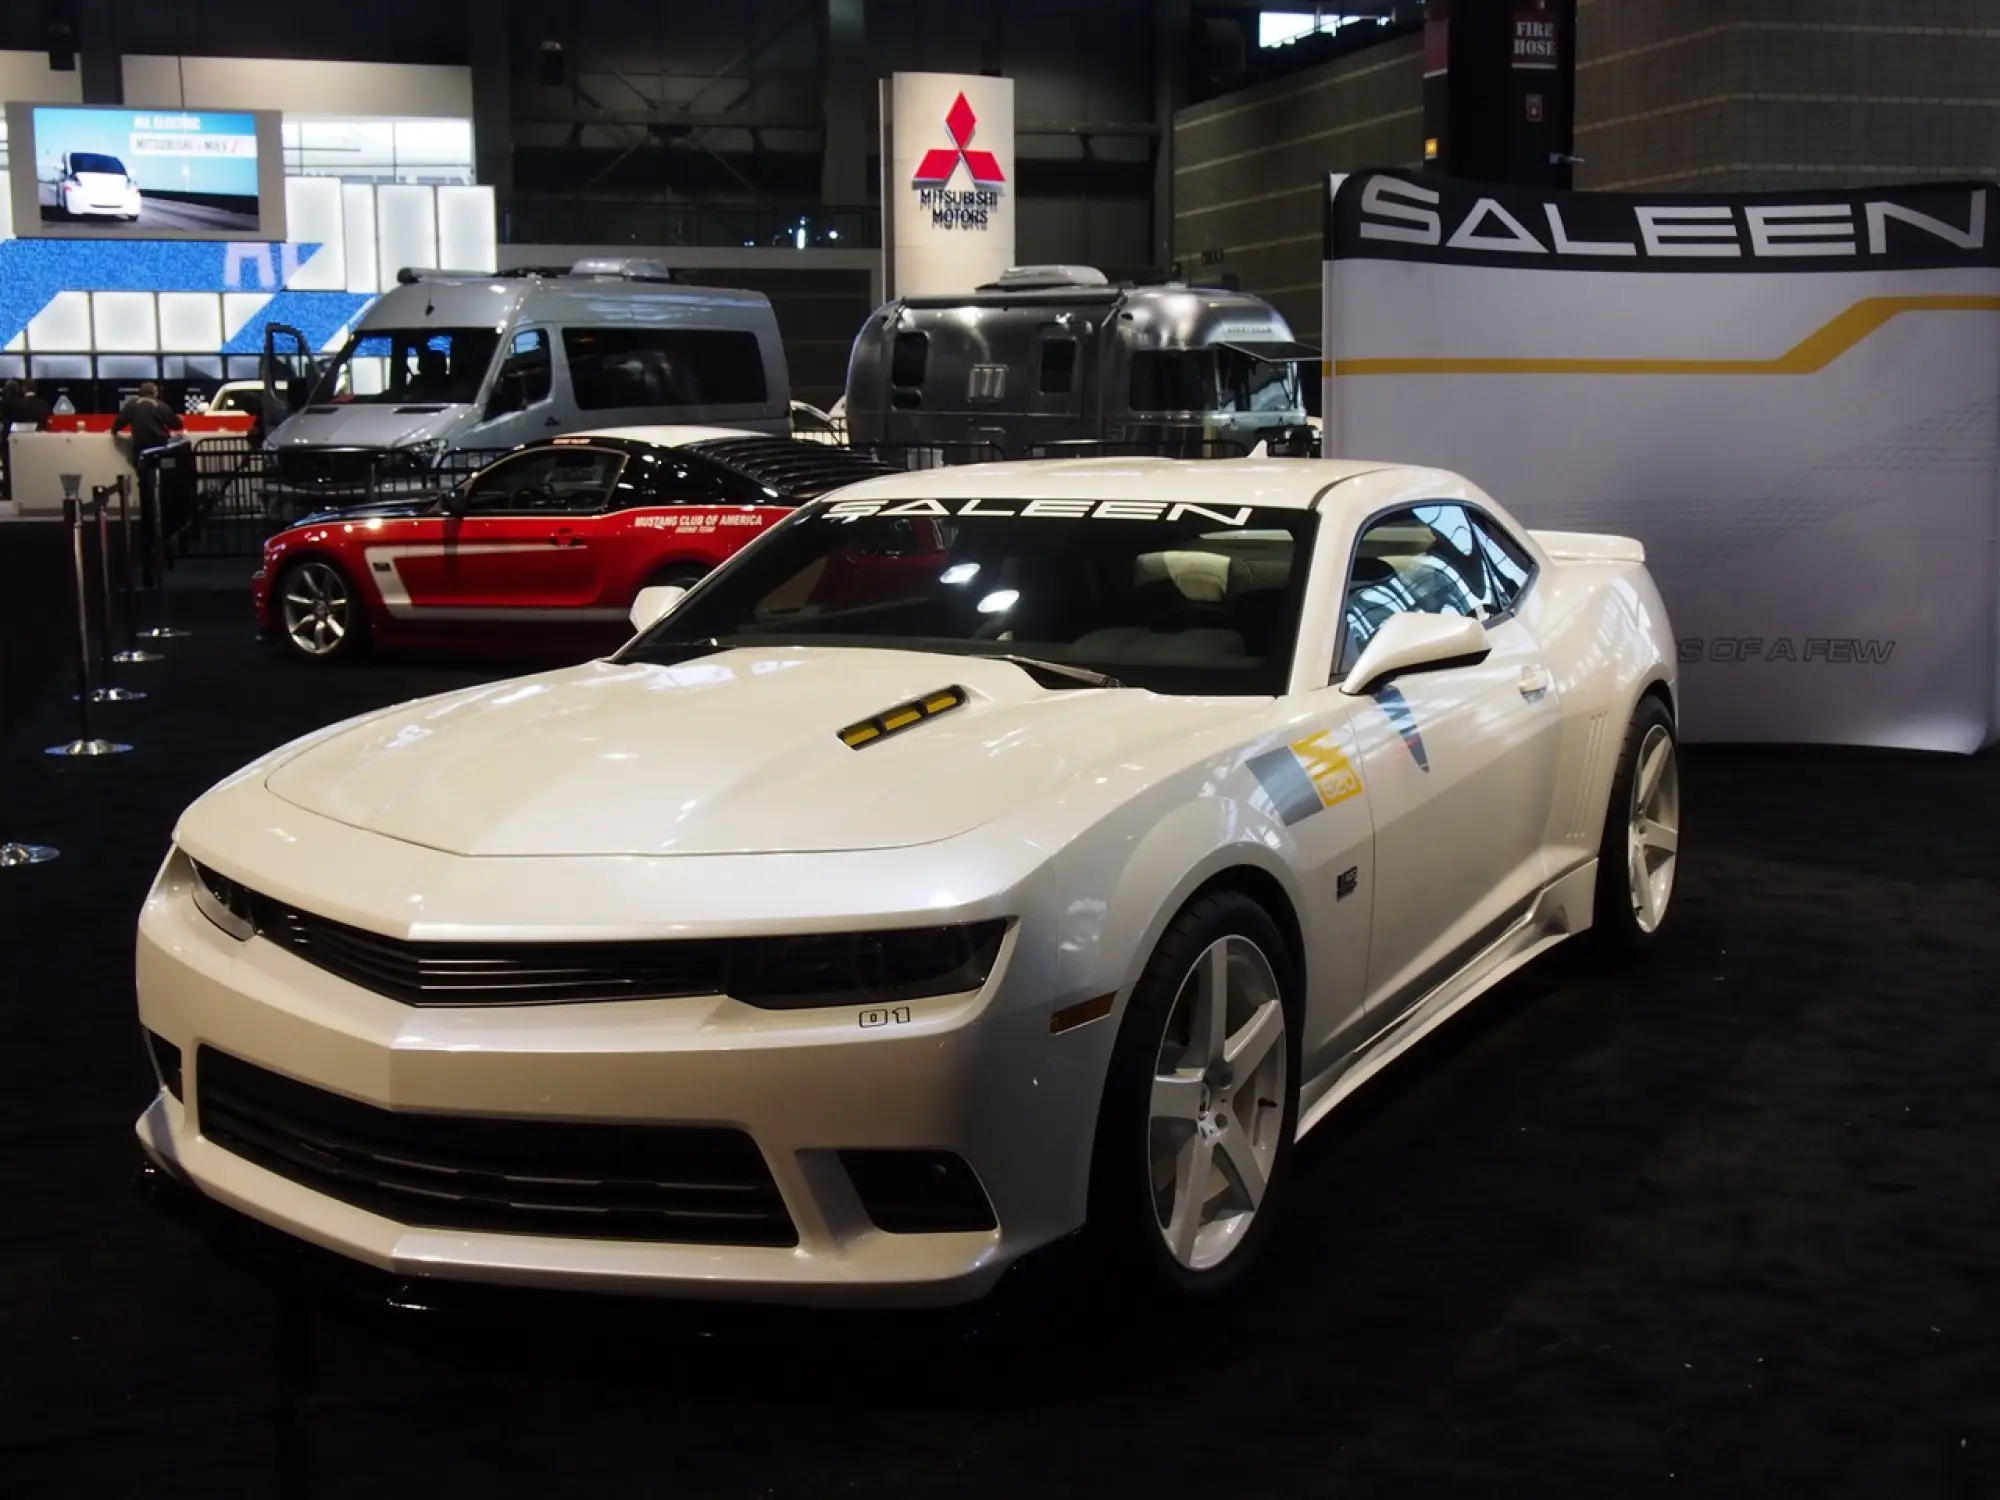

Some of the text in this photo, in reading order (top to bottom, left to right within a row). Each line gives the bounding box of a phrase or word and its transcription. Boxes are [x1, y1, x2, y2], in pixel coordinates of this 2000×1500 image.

[1516, 21, 1554, 37] FIRE
[1513, 38, 1557, 56] HOSE
[920, 187, 998, 207] MITSUBISHI
[932, 207, 988, 226] MOTORS
[1360, 174, 1986, 257] SALEEN
[634, 514, 763, 527] MUSTANG CLUB OF AMERICA
[822, 499, 1252, 526] SALEEN
[1709, 637, 1764, 662] OF
[1764, 637, 1797, 662] A
[1802, 638, 1896, 665] FEW
[859, 1006, 910, 1028] 01
